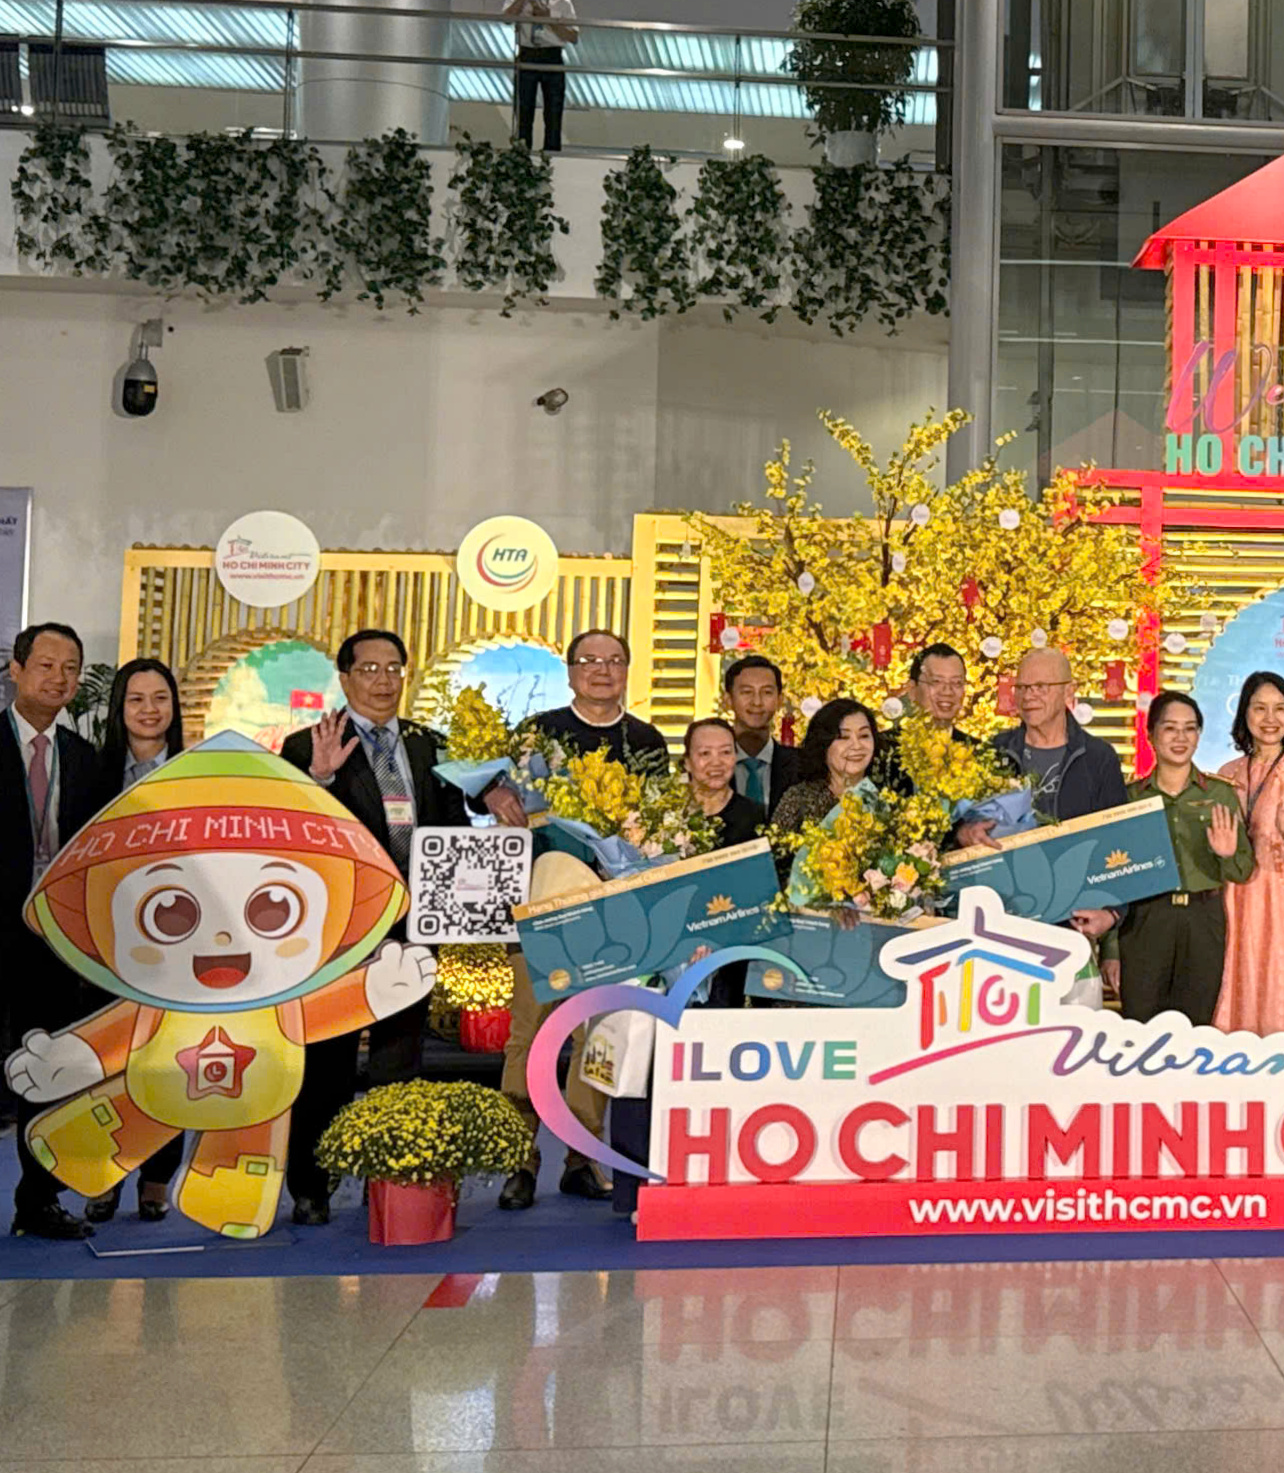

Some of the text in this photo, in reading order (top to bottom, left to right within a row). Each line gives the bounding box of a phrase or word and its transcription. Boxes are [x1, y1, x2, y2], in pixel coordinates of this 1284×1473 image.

[1165, 433, 1223, 476] HO
[222, 561, 311, 571] HO CHI MINH CITY
[492, 548, 529, 562] HTA
[60, 815, 381, 867] HO CHI MINH CITY
[667, 1103, 817, 1184] HO
[838, 1101, 1002, 1182] CHI
[1027, 1100, 1267, 1181] MINH
[909, 1189, 1267, 1224] www.visithcmc.vn
